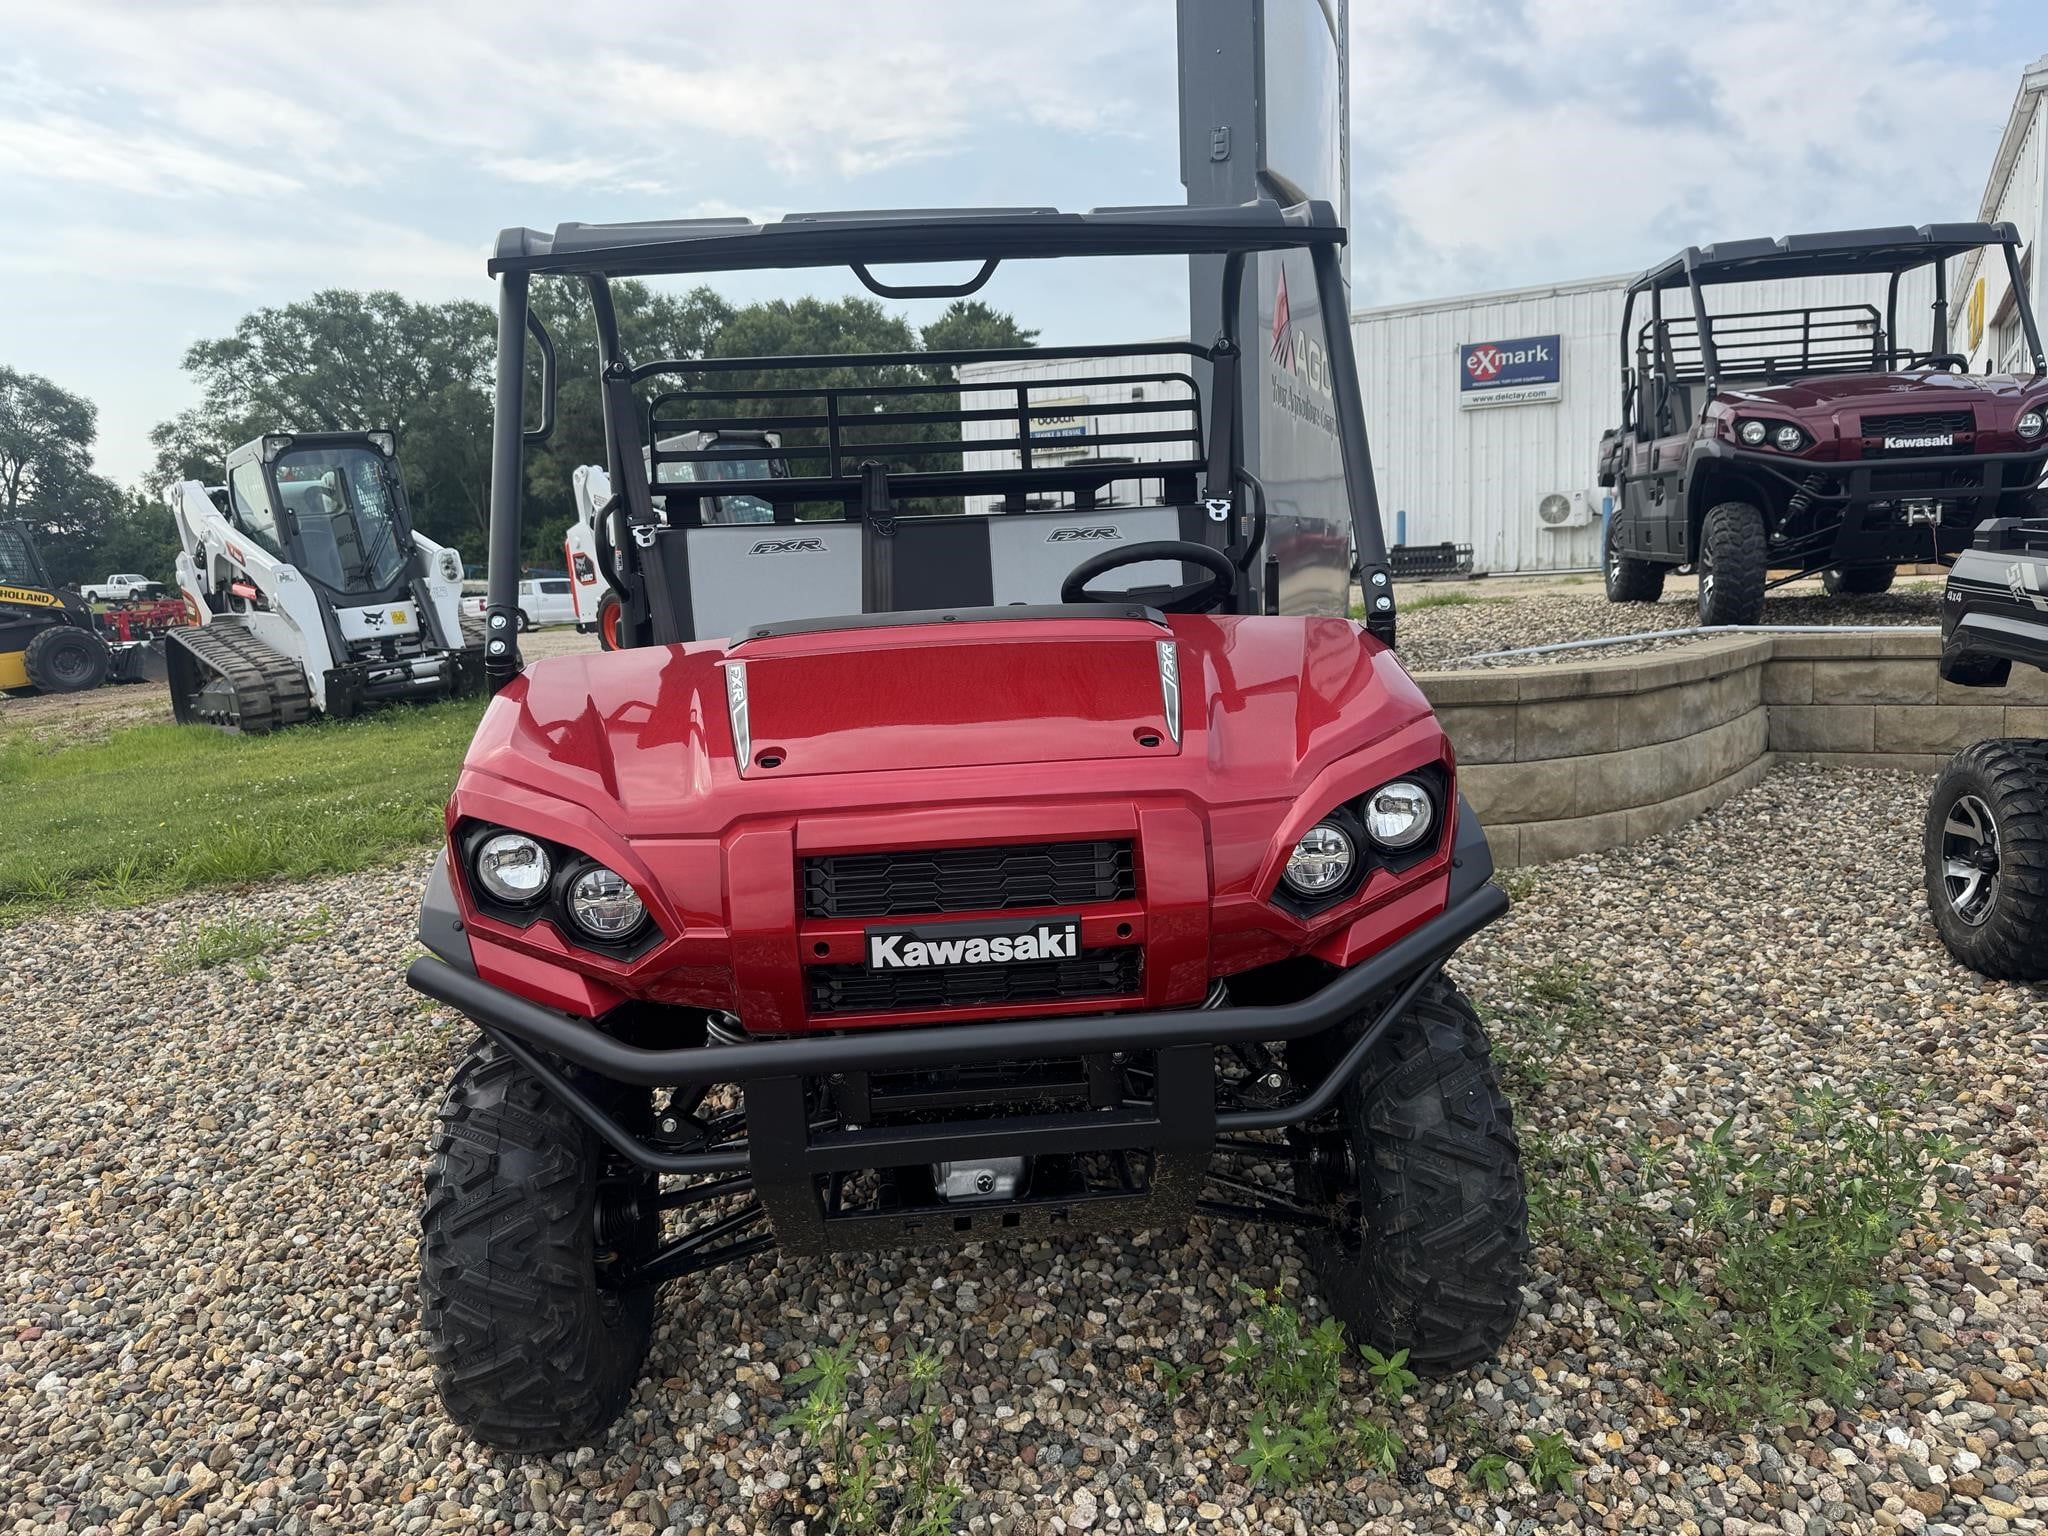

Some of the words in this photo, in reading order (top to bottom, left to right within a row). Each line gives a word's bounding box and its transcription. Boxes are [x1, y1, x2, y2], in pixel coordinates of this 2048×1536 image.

[1296, 329, 1333, 401] AGC
[1884, 434, 1953, 449] Kawasaki
[749, 537, 828, 555] FXR
[1046, 525, 1122, 543] FXR
[0, 590, 49, 603] HOLLAND
[1161, 643, 1174, 681] FXR
[730, 665, 744, 703] FXR
[871, 925, 1077, 969] Kawasaki
